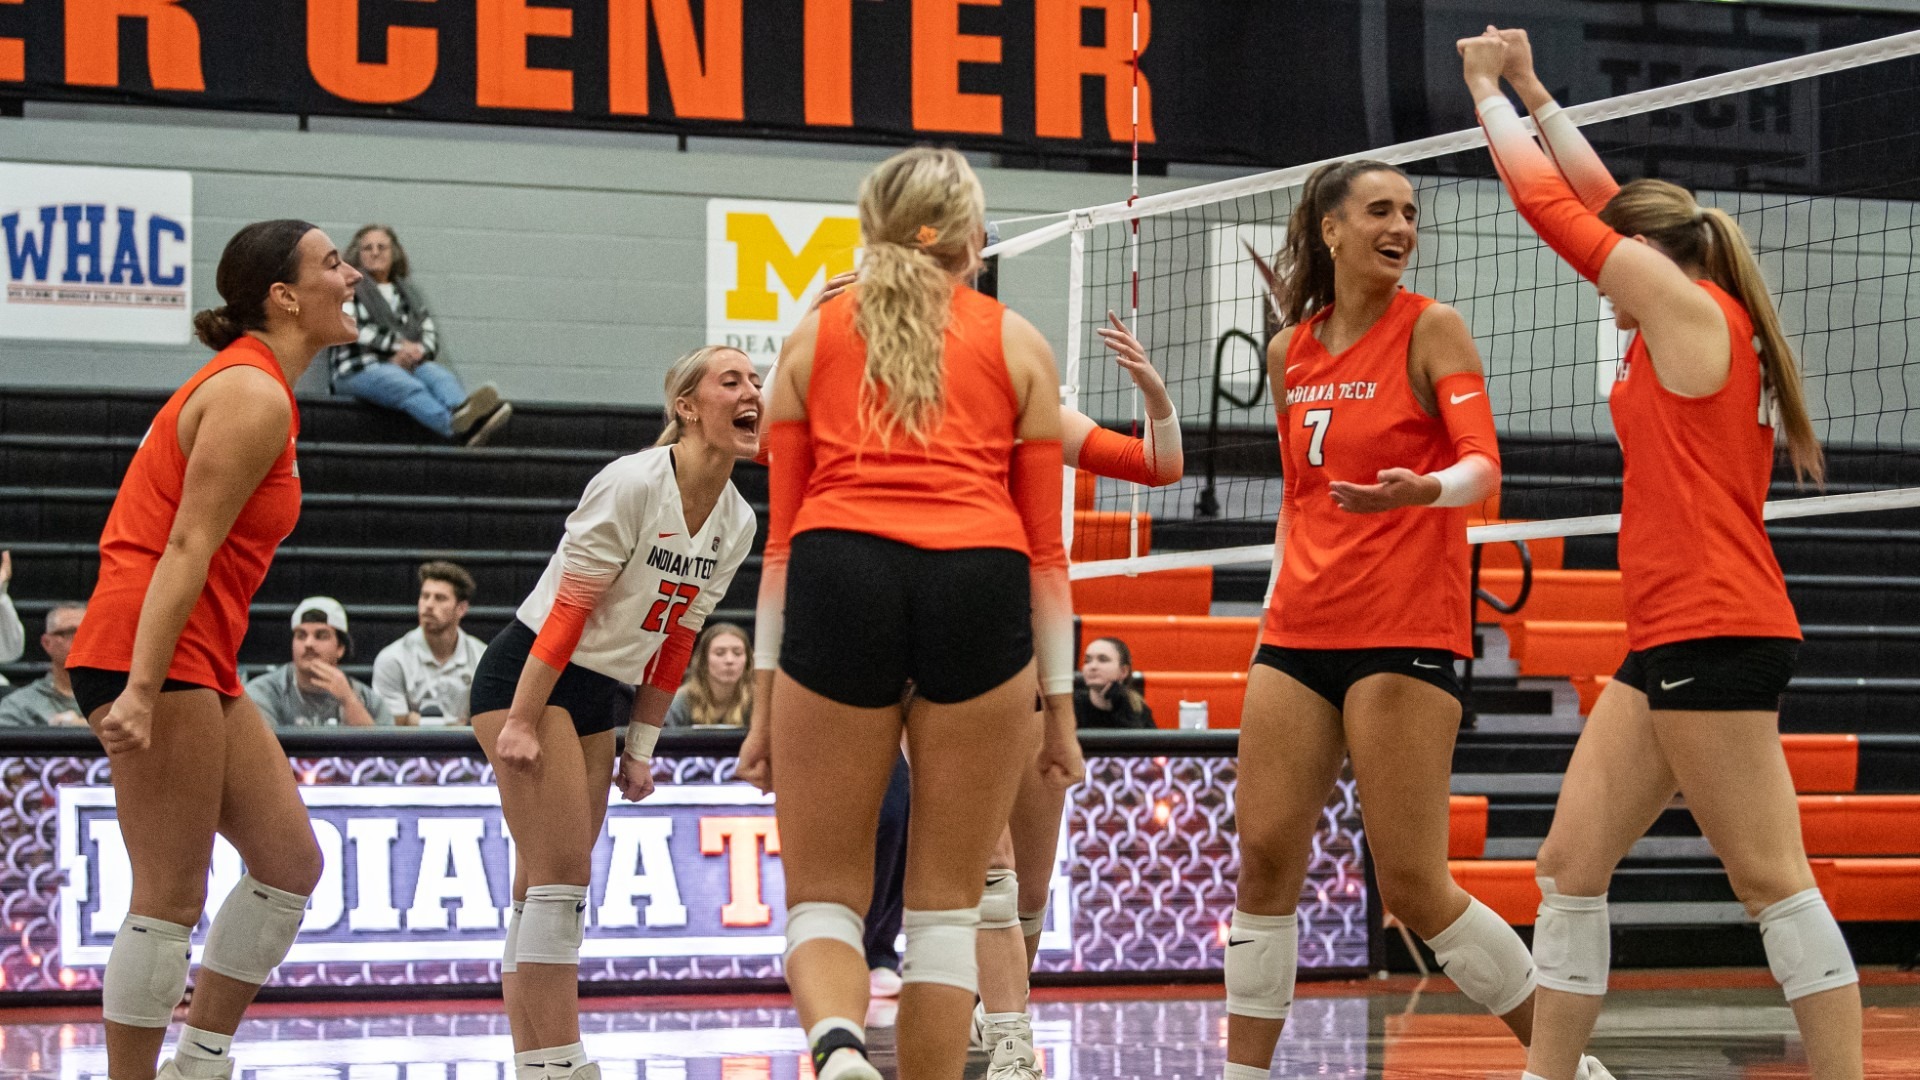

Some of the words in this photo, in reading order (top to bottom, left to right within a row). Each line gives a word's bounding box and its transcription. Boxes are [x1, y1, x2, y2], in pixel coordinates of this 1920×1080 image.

[307, 0, 1157, 143] CENTER
[1, 203, 186, 286] WHAC
[726, 212, 864, 321] M
[726, 334, 788, 353] DEA
[1338, 381, 1378, 400] TECH
[1303, 407, 1333, 467] 7
[694, 556, 718, 580] TEC
[640, 579, 700, 634] 22
